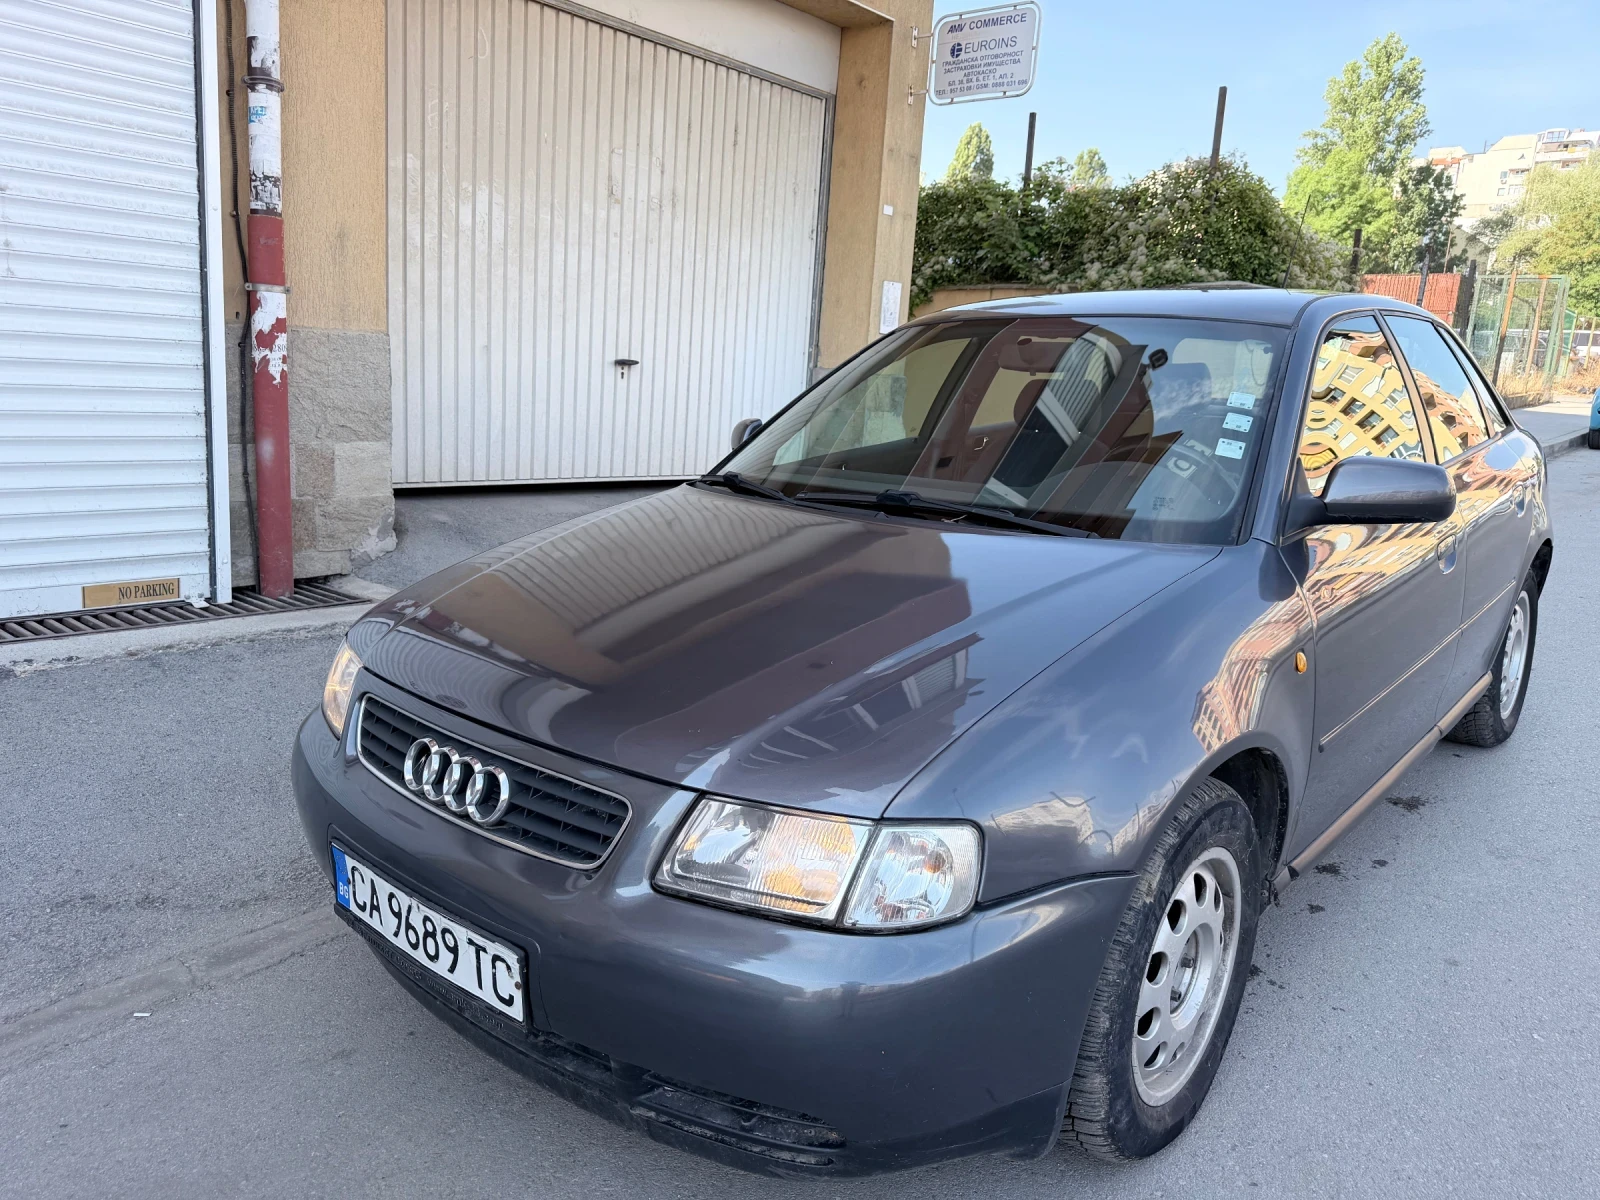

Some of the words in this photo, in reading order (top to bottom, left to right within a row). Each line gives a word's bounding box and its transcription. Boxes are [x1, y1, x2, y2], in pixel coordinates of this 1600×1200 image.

[947, 23, 966, 34] AMV
[969, 13, 1027, 30] COMMERCE
[964, 36, 1017, 53] EUROINS
[942, 56, 979, 68] ГРАЖДАНСКА
[979, 50, 1024, 62] ОТГОВОРНОСТ
[943, 63, 982, 74] ЗАСТРАХОВКИ
[983, 58, 1021, 69] ИМУЩЕСТВА
[963, 68, 997, 78] АВТОКАСКО
[118, 586, 132, 601] NO
[134, 582, 175, 599] PARKING
[339, 881, 349, 899] BG
